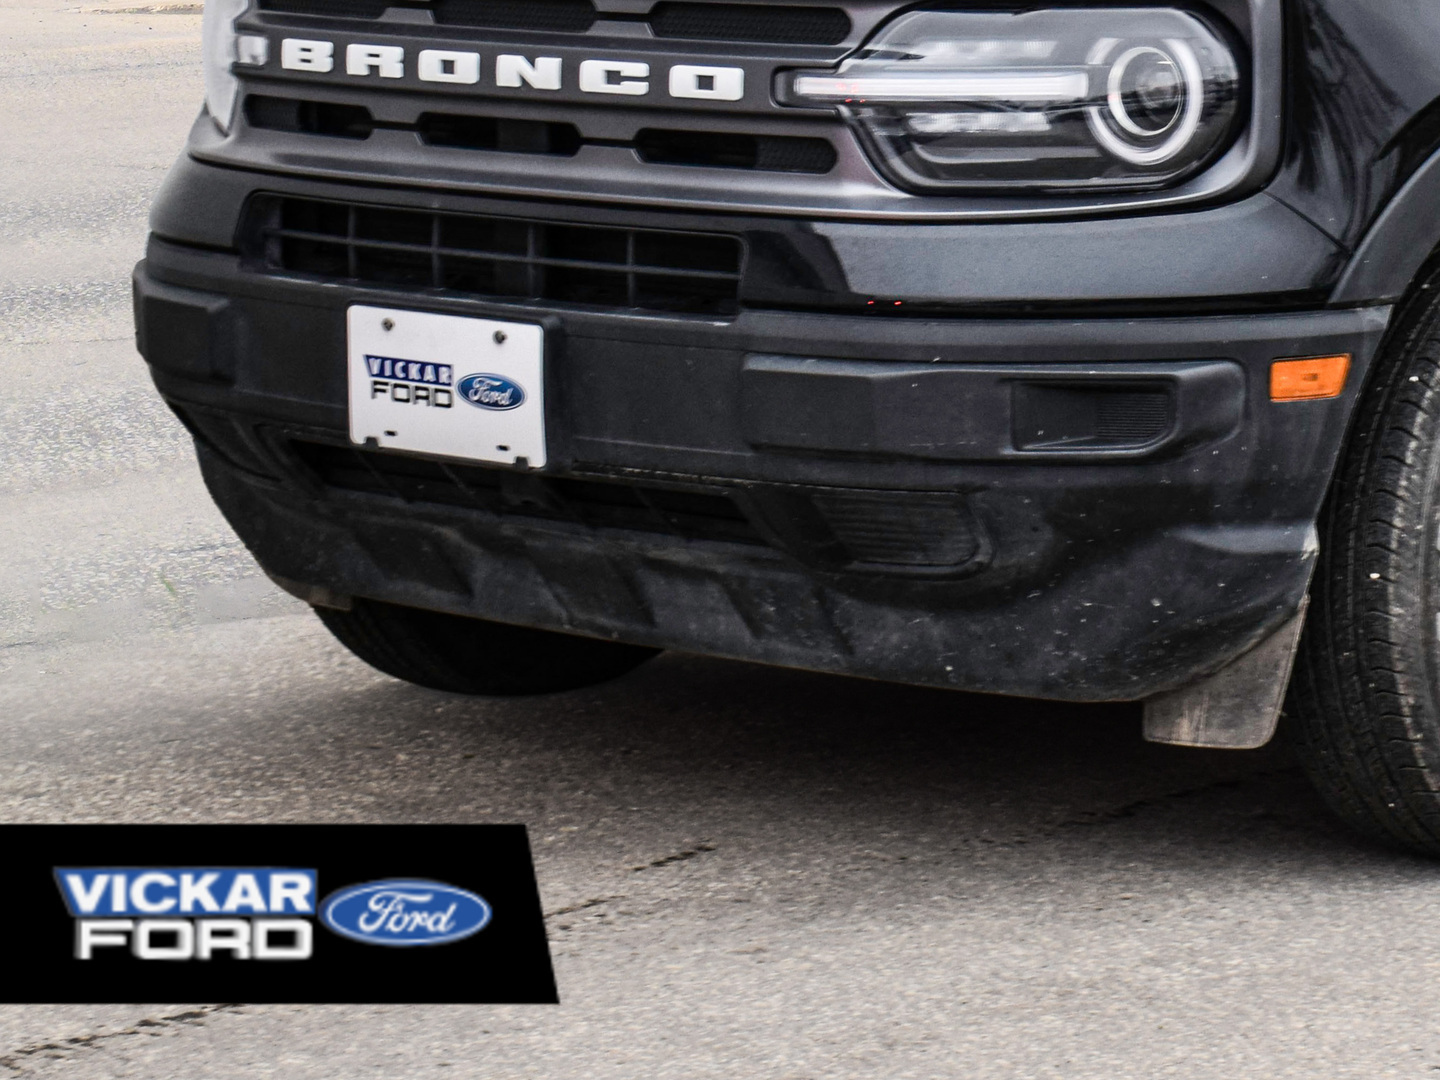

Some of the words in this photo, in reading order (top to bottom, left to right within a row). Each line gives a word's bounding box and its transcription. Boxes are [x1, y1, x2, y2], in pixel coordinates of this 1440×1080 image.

[281, 37, 746, 101] BRONCO
[368, 357, 452, 385] VICKAR
[371, 380, 454, 409] FORD
[468, 377, 514, 406] Ford
